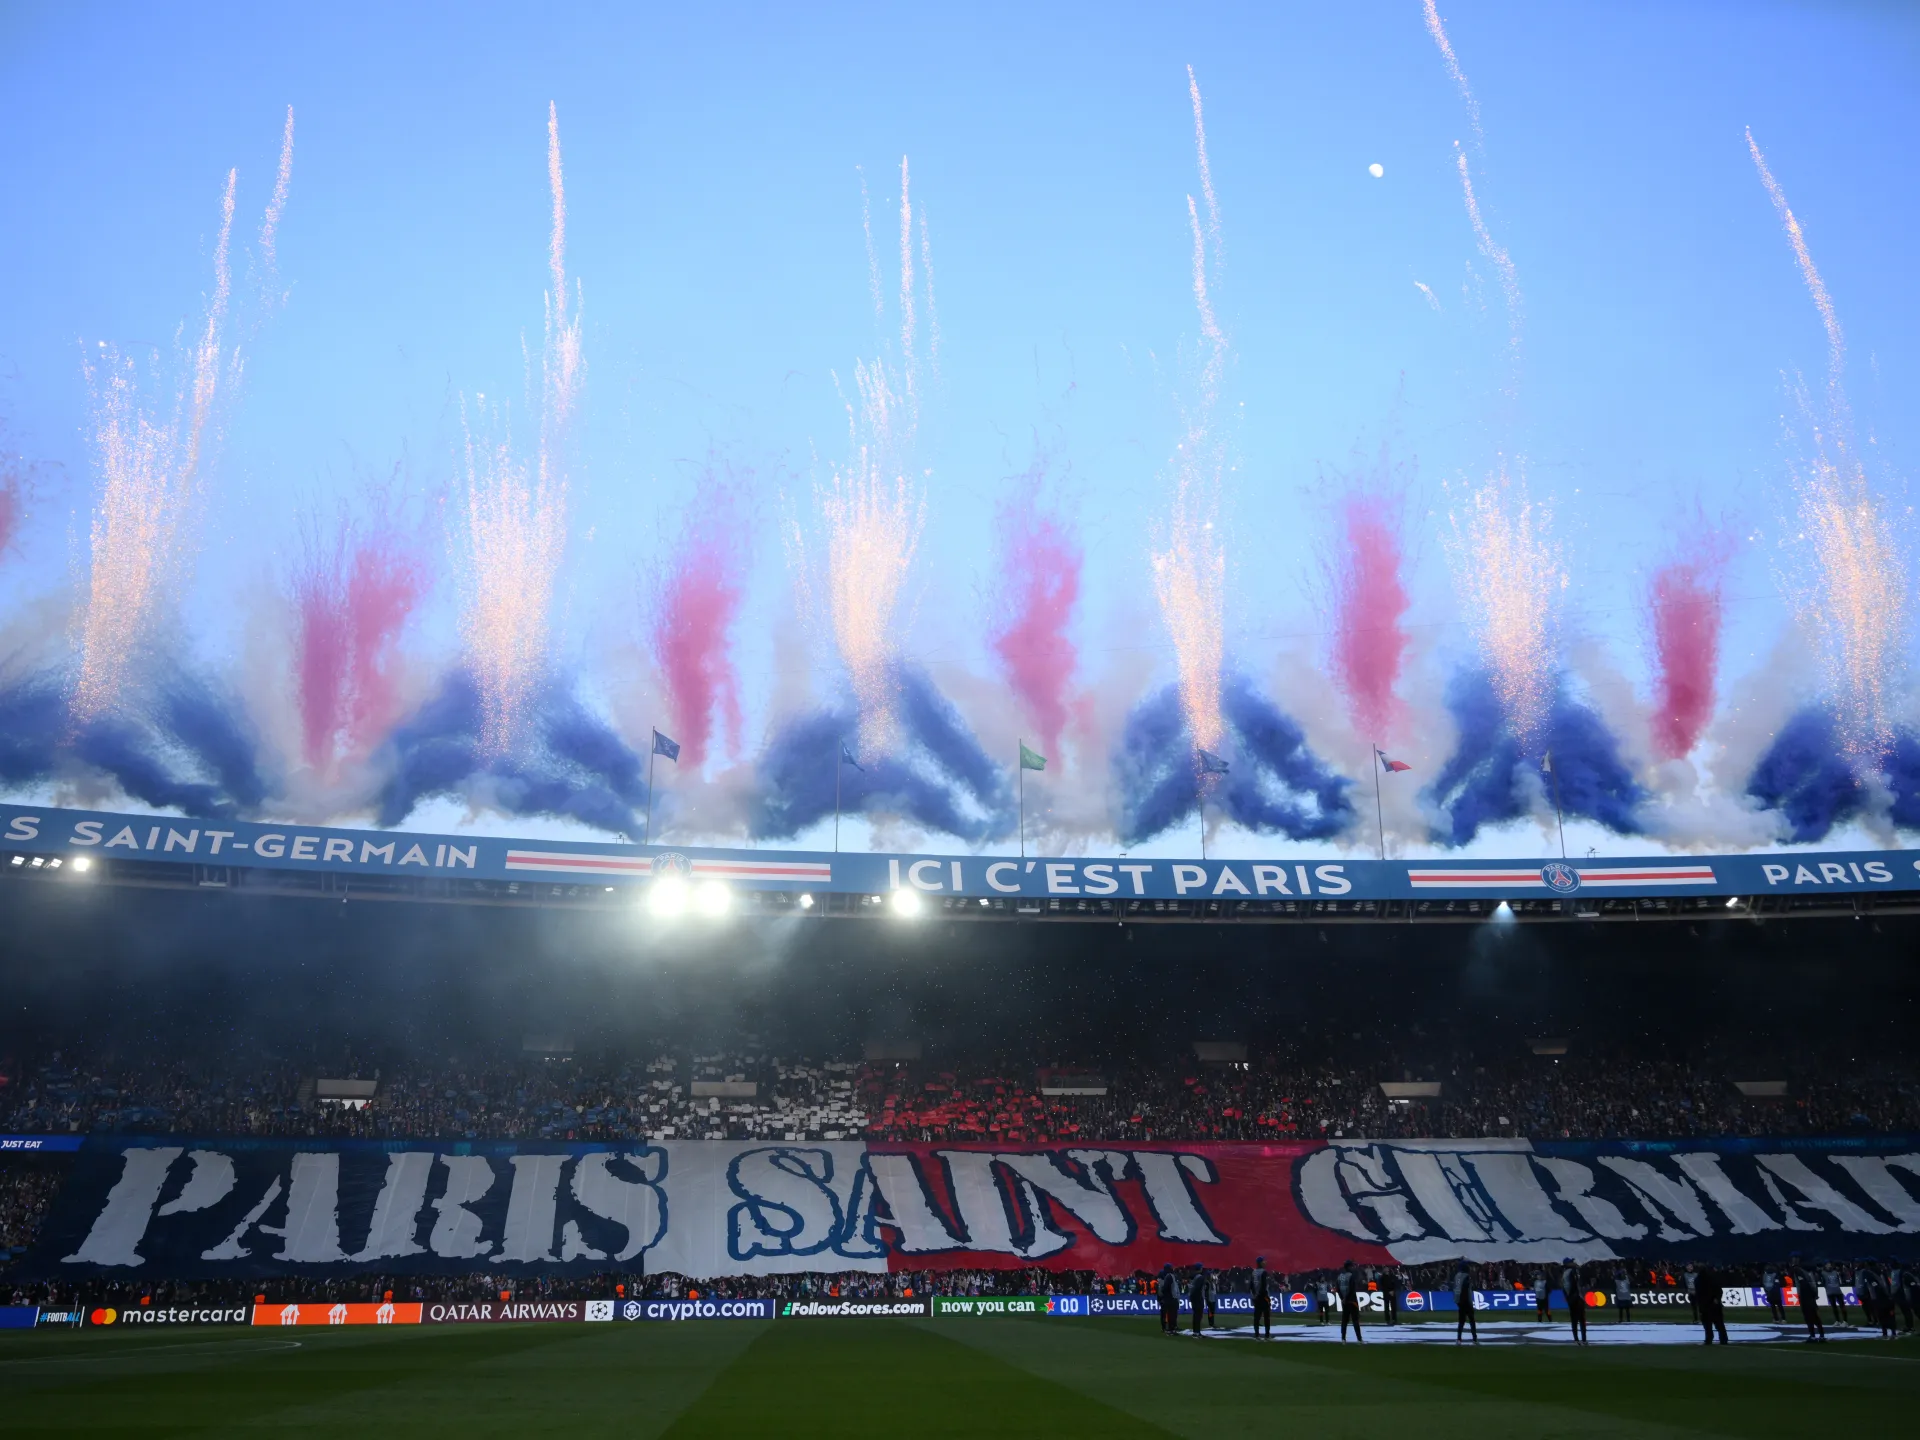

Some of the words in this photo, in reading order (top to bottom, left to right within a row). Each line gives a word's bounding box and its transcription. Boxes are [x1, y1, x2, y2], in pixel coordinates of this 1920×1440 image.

[69, 821, 478, 868] SAINT-GERMAIN
[888, 859, 963, 891] ICI
[1171, 864, 1352, 895] PARIS
[1762, 862, 1893, 886] PARIS
[1, 1141, 23, 1149] JUST
[24, 1140, 43, 1149] EAT
[60, 1146, 668, 1268] PARIS
[726, 1146, 1232, 1261] SAINT
[790, 1301, 925, 1316] FollowScores.com
[941, 1301, 974, 1313] now
[976, 1301, 1005, 1315] you
[1007, 1301, 1036, 1312] can
[1106, 1299, 1139, 1310] UEFA
[1217, 1297, 1256, 1309] LEAGU
[1492, 1293, 1538, 1306] PS5
[122, 1306, 246, 1323] mastercard
[430, 1303, 492, 1321] QATAR
[499, 1302, 578, 1319] AIRWAYS
[647, 1300, 765, 1321] crypto.com
